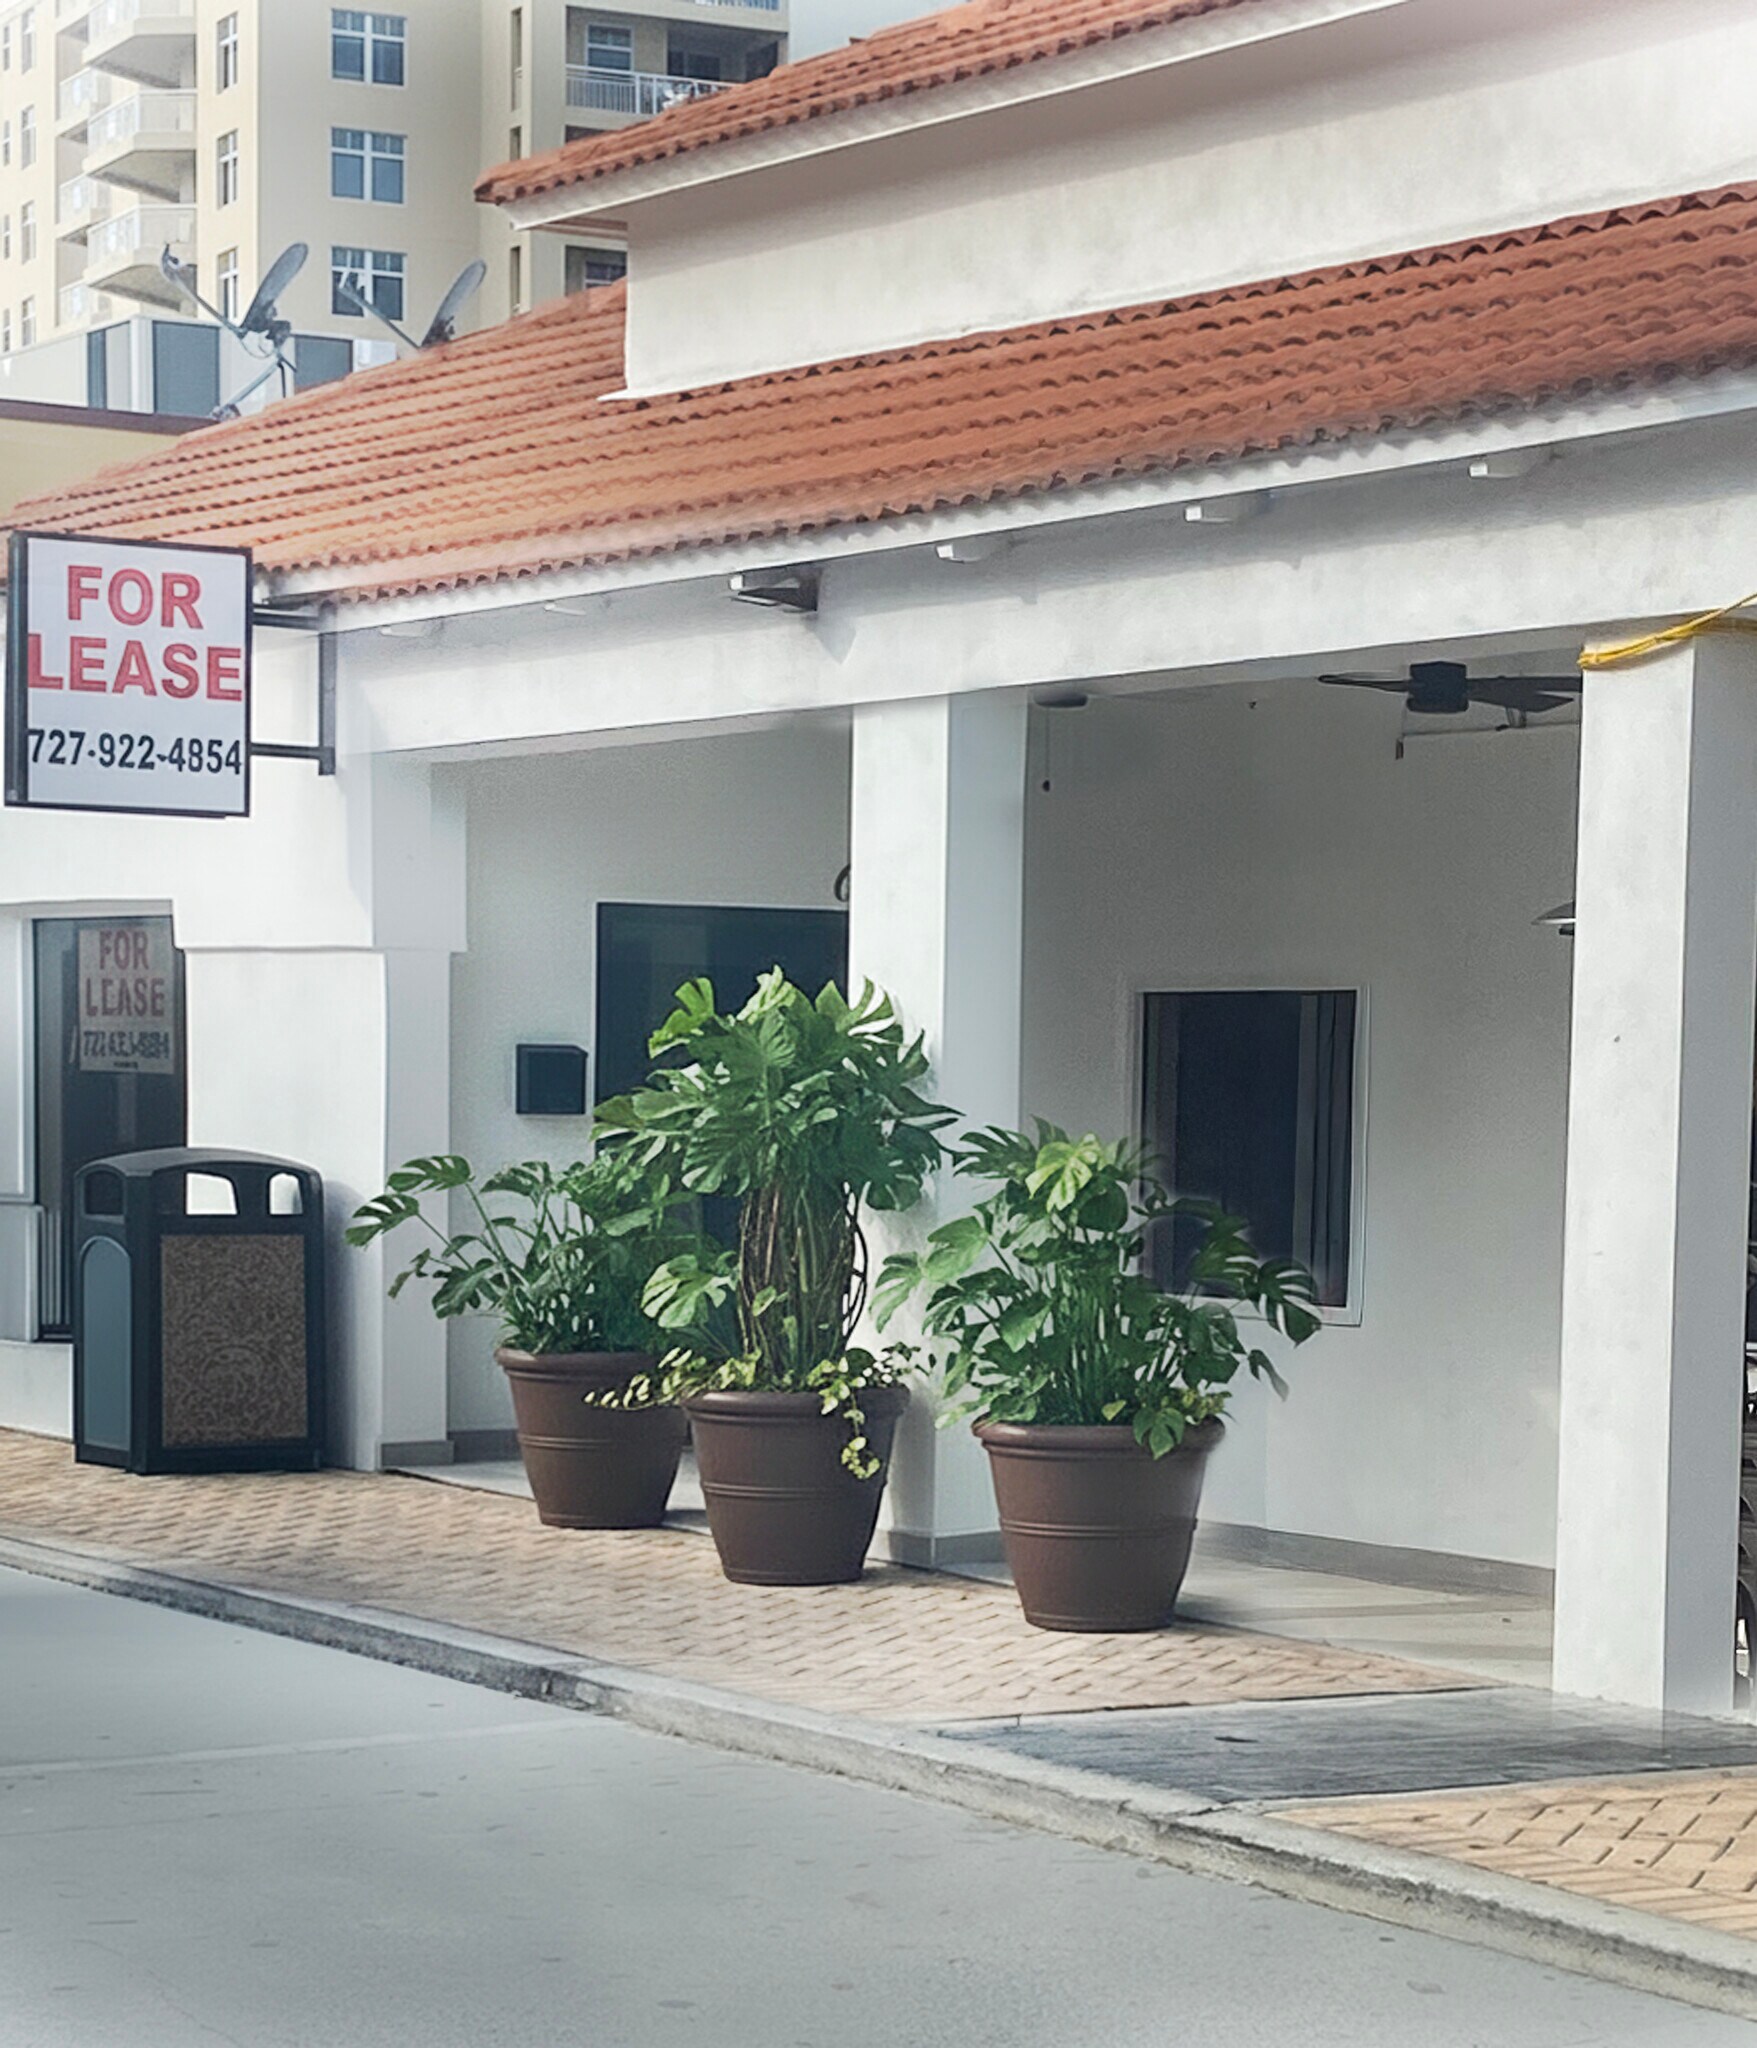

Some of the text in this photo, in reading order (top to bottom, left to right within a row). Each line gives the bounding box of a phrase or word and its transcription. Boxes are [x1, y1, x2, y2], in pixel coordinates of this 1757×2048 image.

[67, 565, 204, 629] FOR
[27, 634, 243, 701] LEASE
[27, 728, 242, 775] 727-922-4854
[100, 929, 149, 970] FOR
[86, 977, 165, 1017] LEASE
